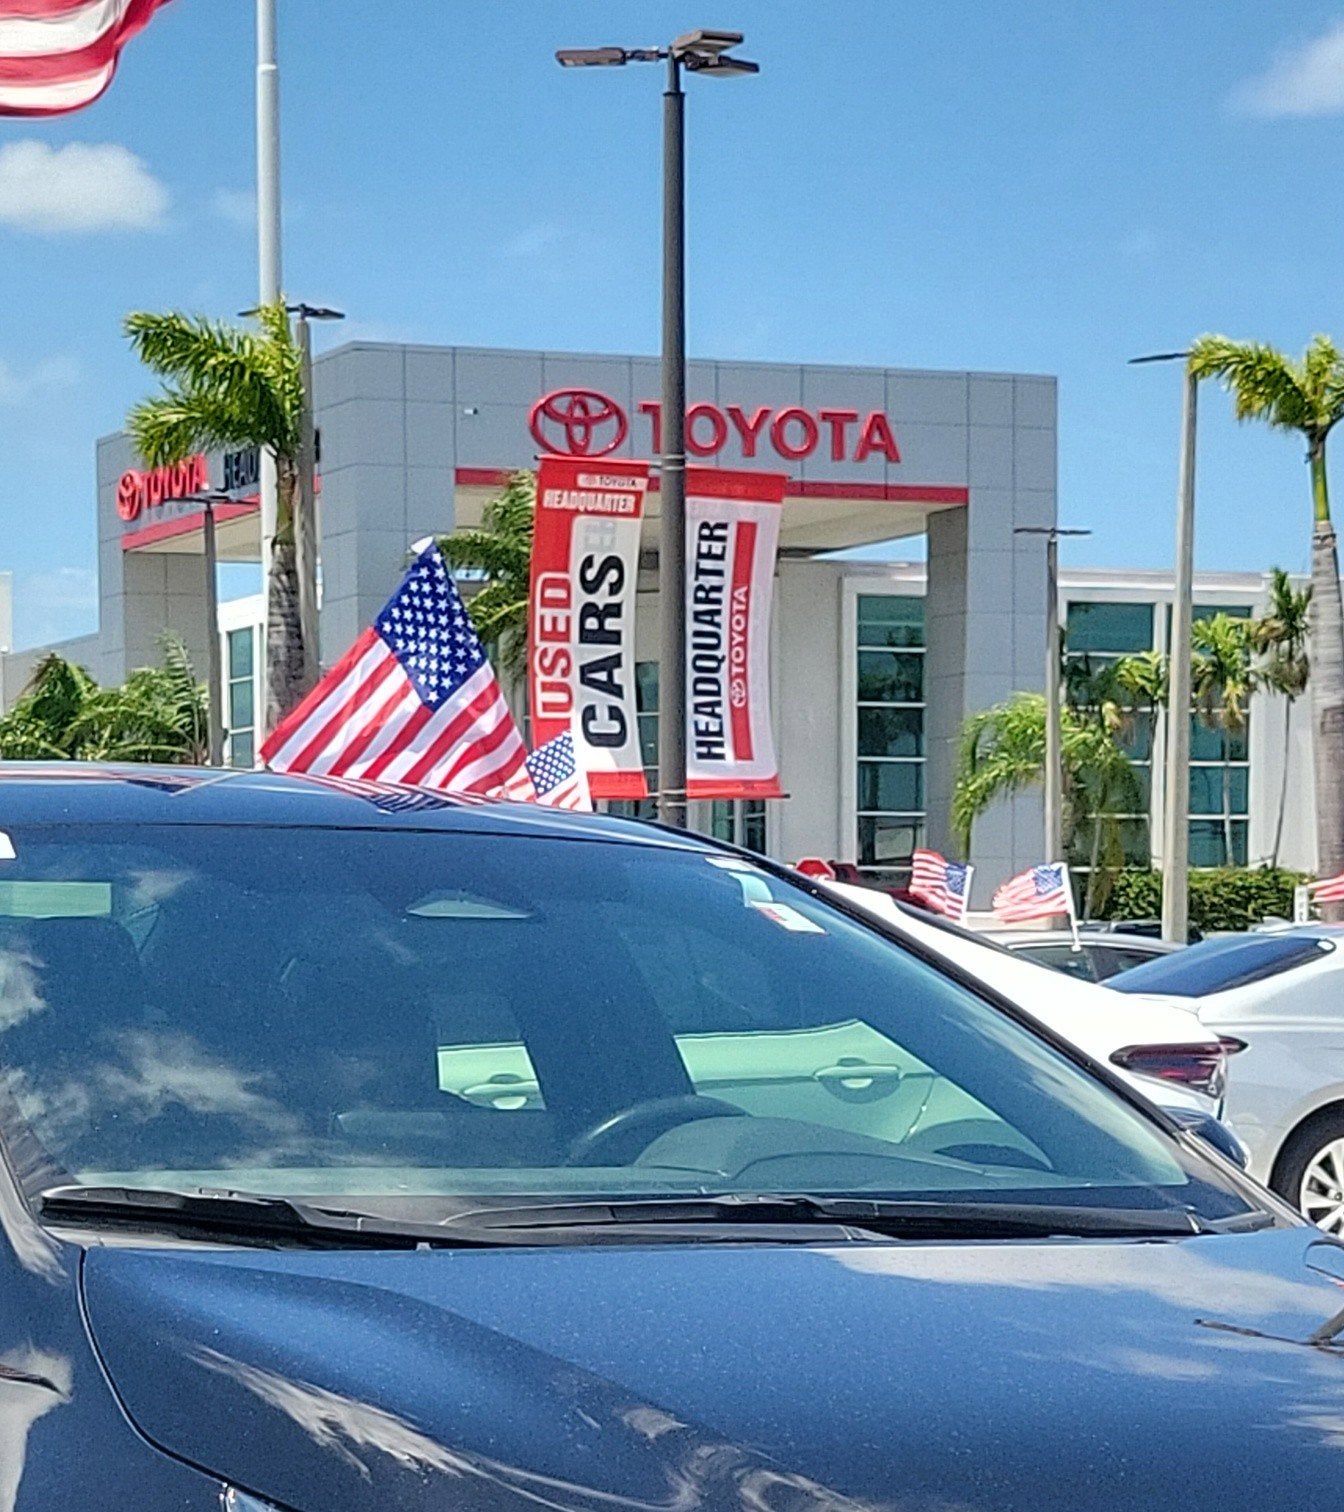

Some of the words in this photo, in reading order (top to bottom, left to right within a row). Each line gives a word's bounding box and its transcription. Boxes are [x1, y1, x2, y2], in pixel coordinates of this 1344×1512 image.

[638, 401, 901, 464] TOYOTA
[535, 573, 574, 717] USED
[579, 554, 628, 748] CARS
[691, 520, 728, 762] HEADQUARTER
[730, 586, 750, 673] TOYOTA
